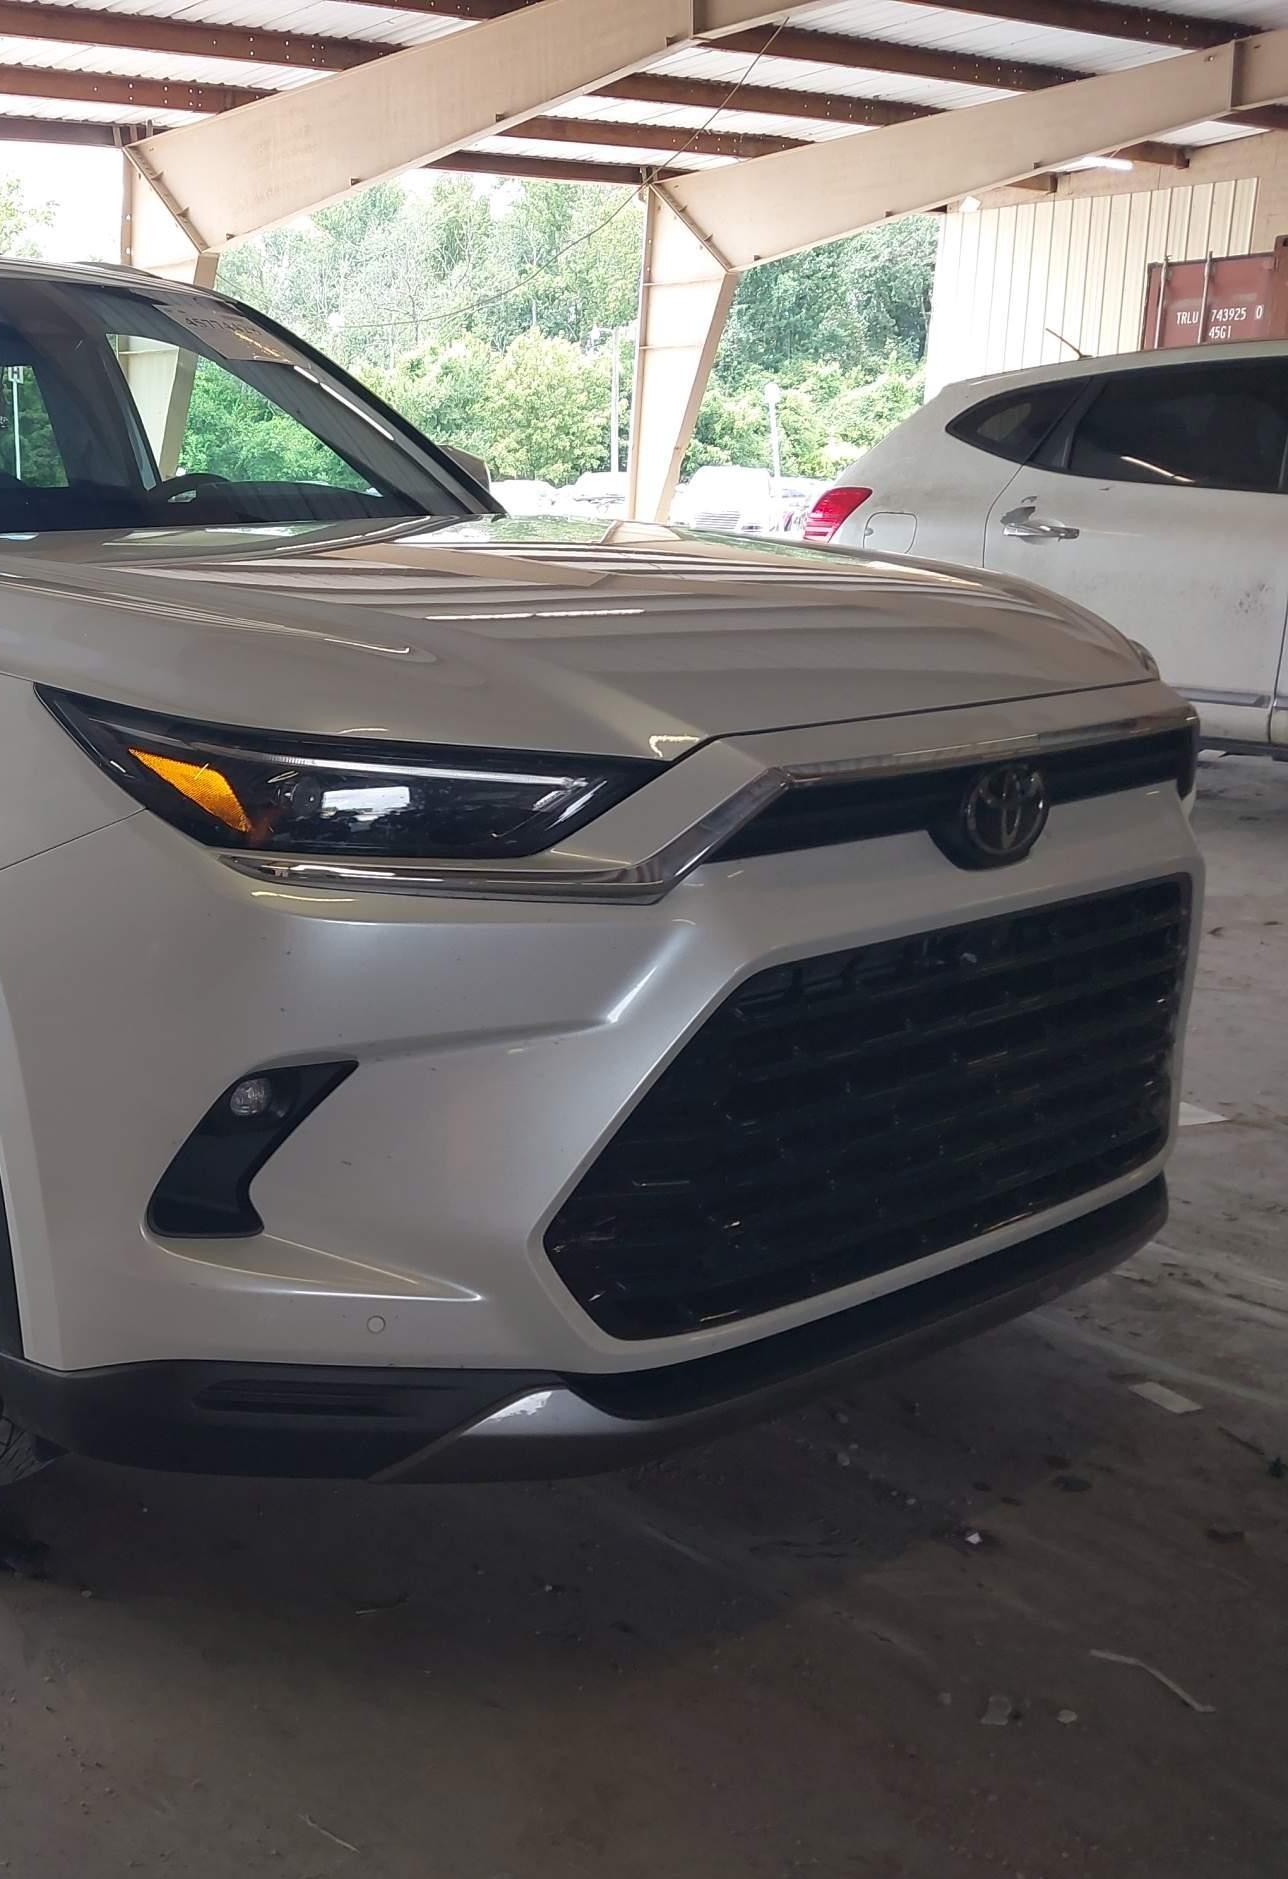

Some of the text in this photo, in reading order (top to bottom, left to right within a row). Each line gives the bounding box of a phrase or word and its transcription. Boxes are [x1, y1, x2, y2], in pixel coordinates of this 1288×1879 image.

[1176, 311, 1200, 325] TRLU
[1210, 307, 1247, 322] 743925
[1208, 325, 1232, 339] 45G1
